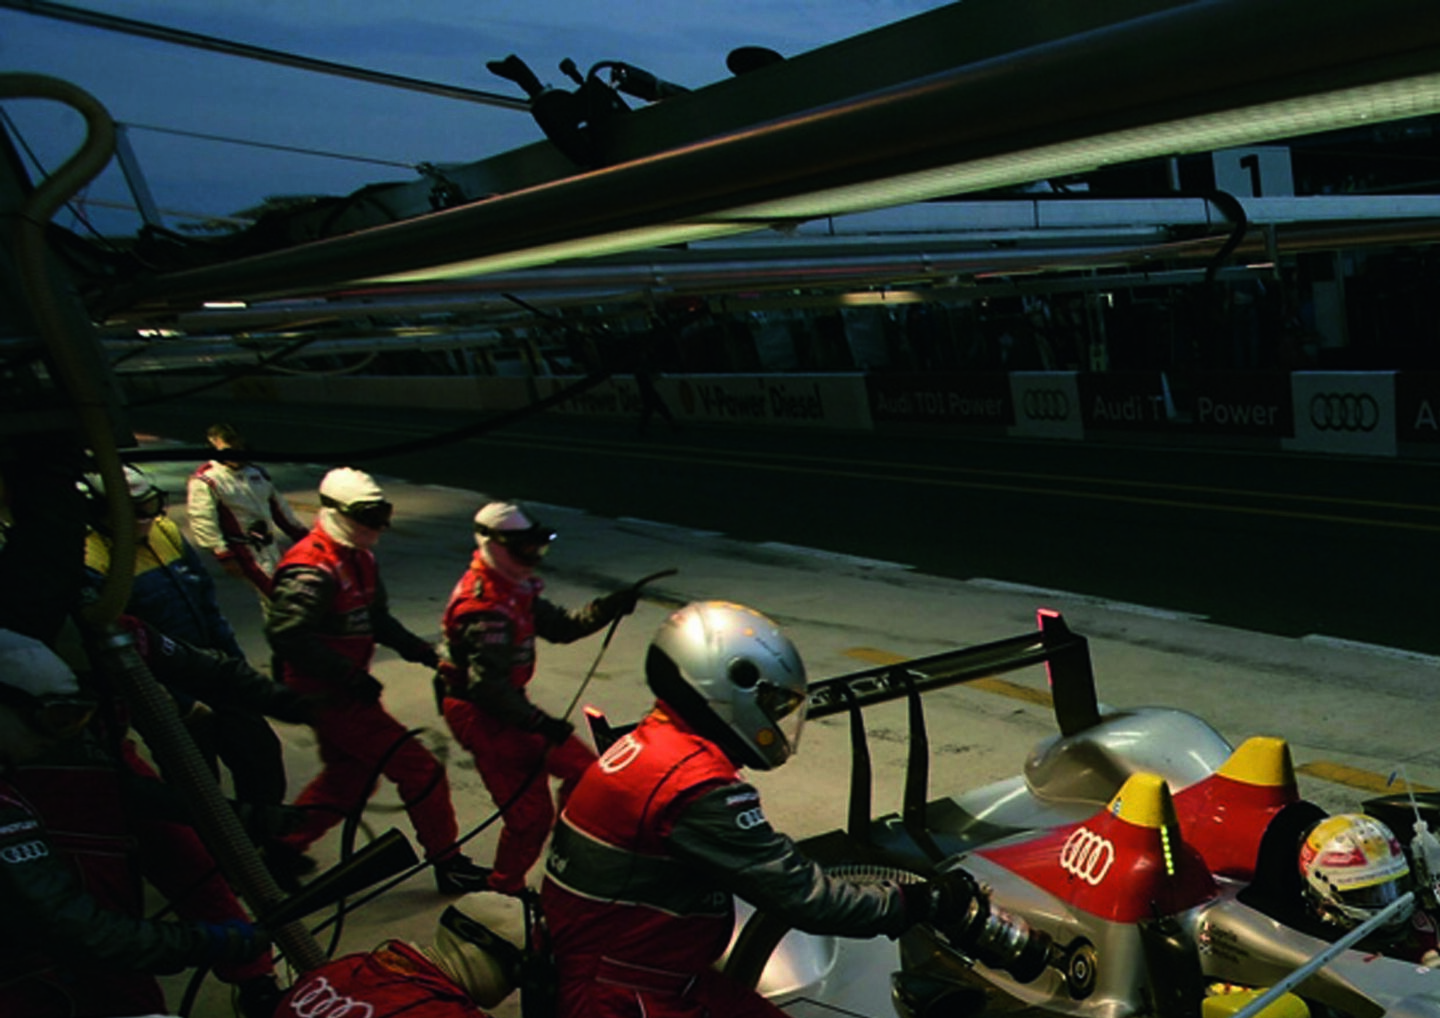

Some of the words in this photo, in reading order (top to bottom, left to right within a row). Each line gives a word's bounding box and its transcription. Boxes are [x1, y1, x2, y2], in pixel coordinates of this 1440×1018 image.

[1240, 154, 1261, 198] 1
[769, 382, 825, 420] Diesel
[876, 391, 913, 417] Audi
[914, 392, 944, 416] TDI
[949, 392, 1002, 418] Power
[1093, 395, 1141, 421] Audi
[1199, 397, 1279, 427] Power
